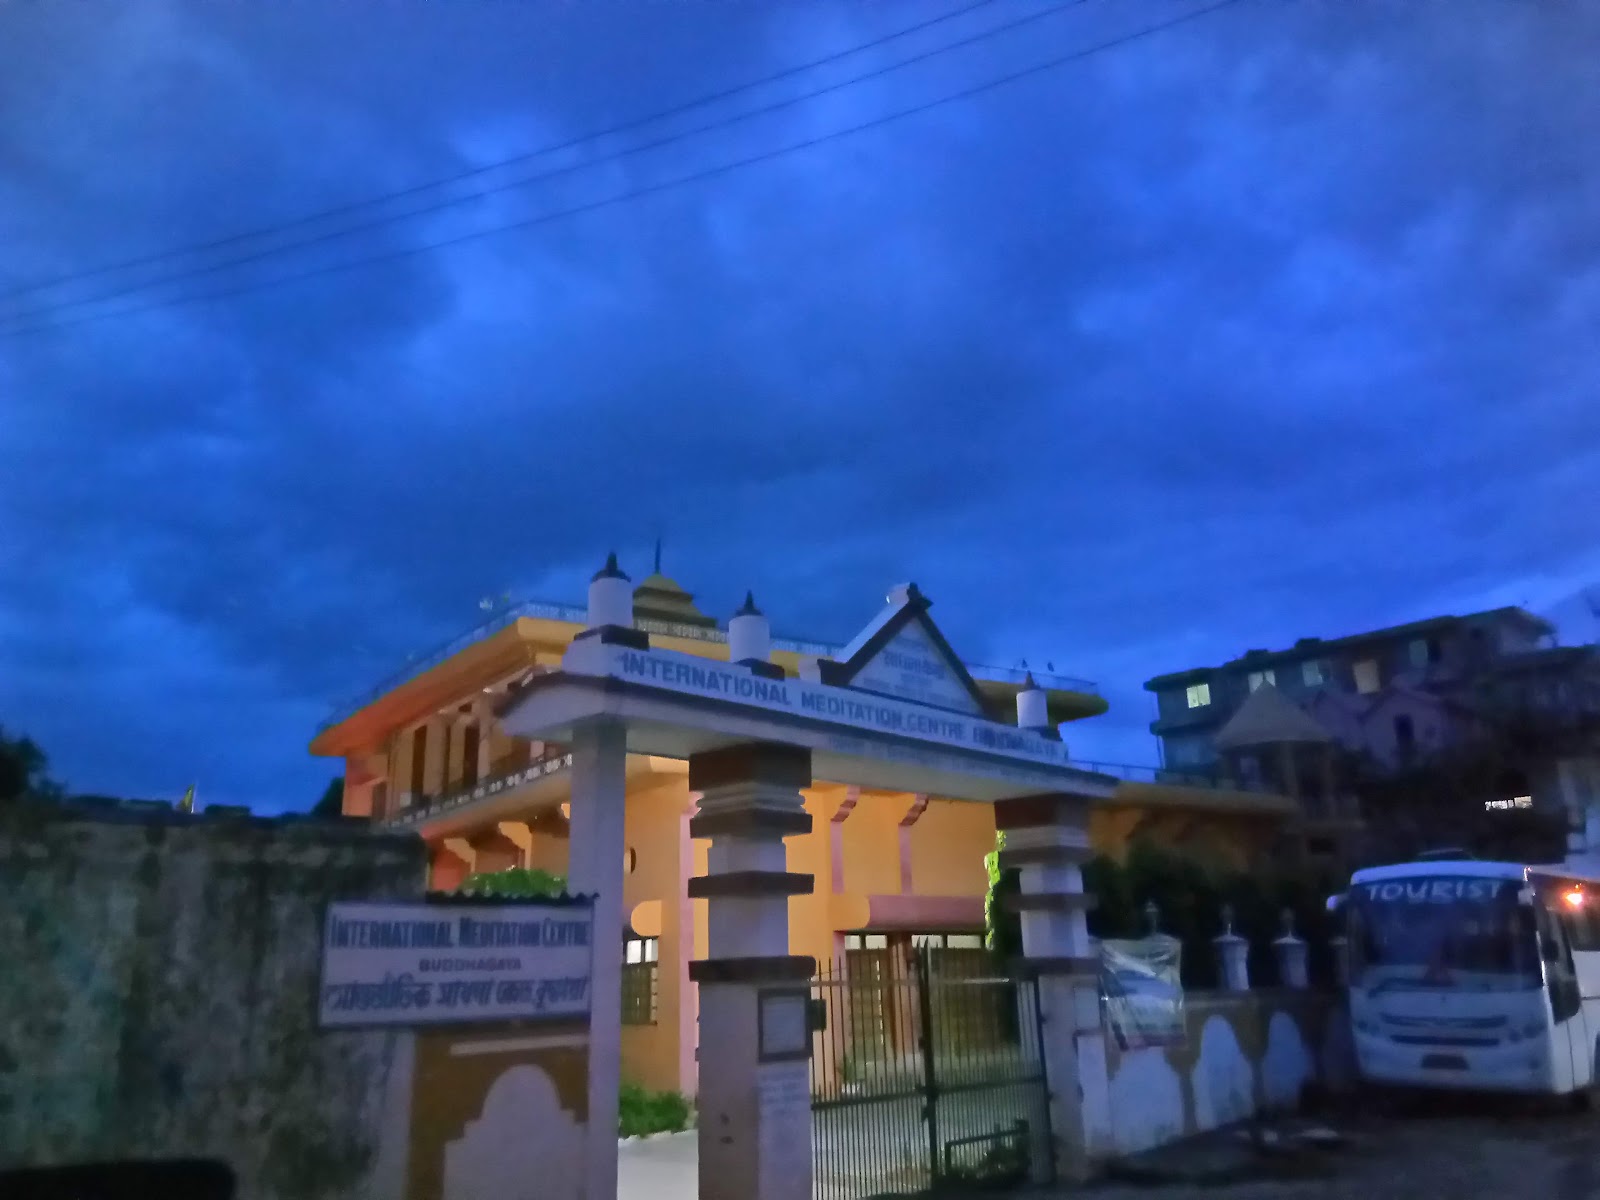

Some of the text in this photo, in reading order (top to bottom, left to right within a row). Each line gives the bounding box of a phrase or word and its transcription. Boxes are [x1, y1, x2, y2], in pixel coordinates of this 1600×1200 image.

[621, 651, 792, 706] INTERNATIONAL
[801, 691, 902, 733] MEDITATION
[906, 712, 964, 741] CENTRE
[1367, 880, 1505, 903] TOURIST
[418, 957, 522, 973] BUDDHAGAYA
